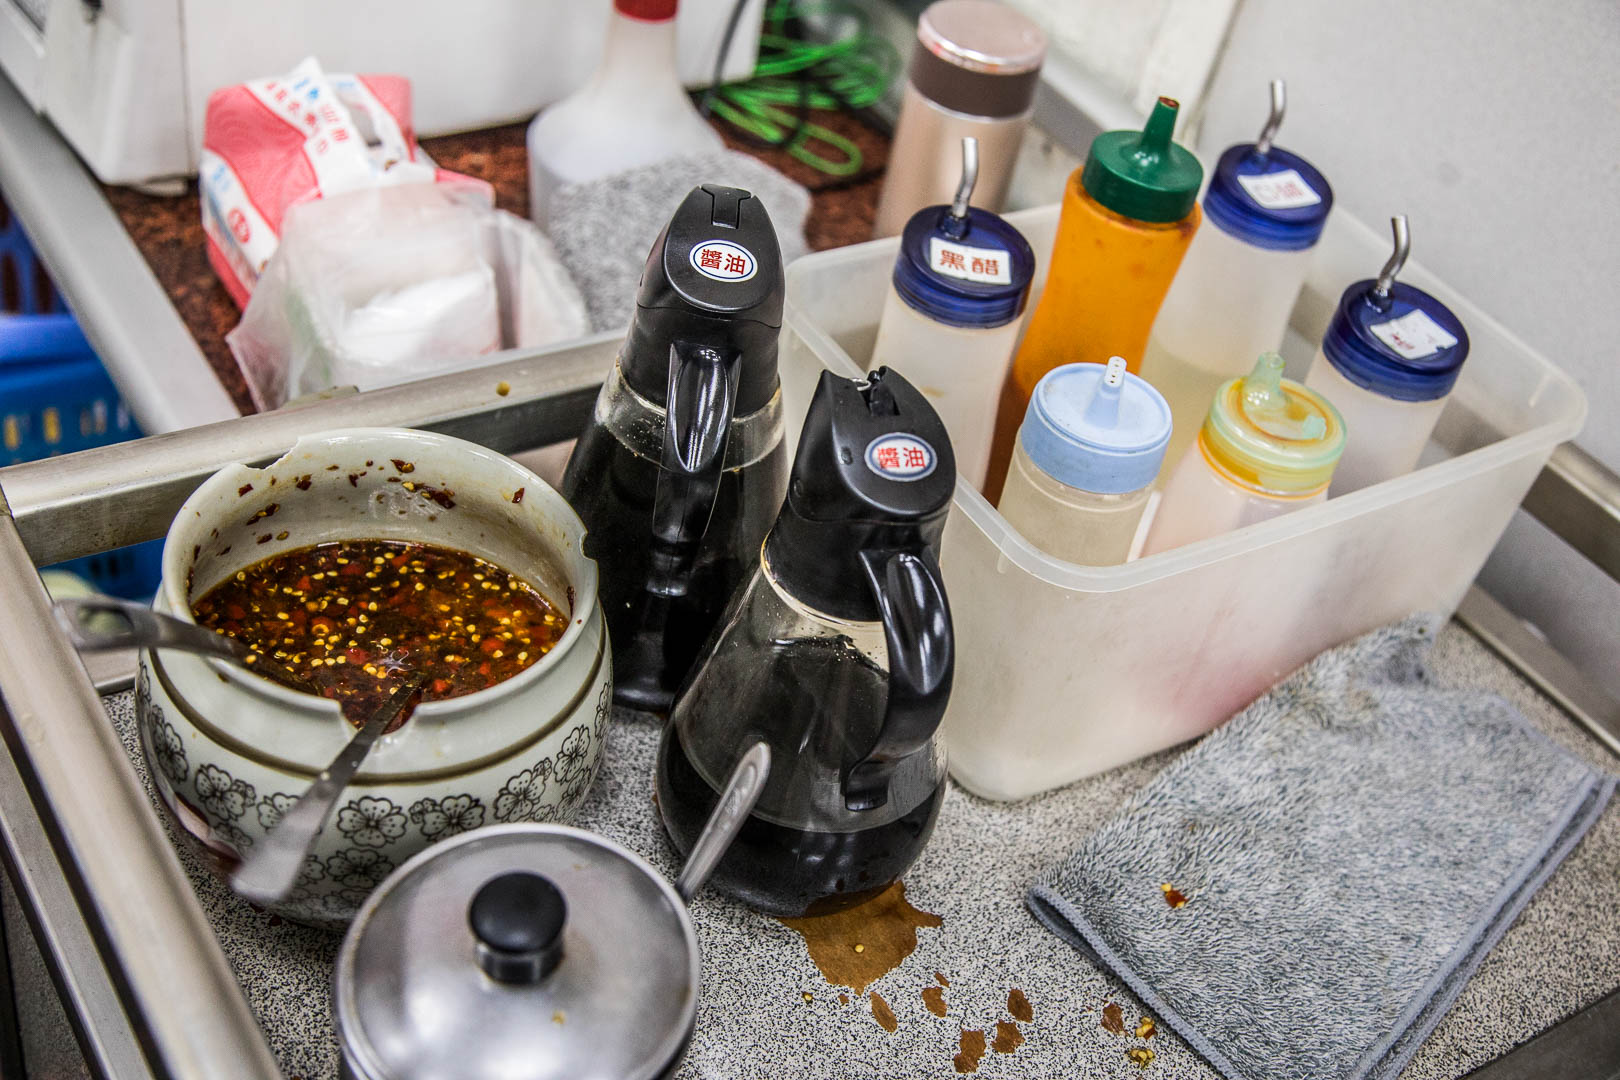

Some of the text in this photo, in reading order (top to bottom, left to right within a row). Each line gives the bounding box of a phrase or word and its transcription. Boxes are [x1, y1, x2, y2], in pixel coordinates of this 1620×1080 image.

[701, 249, 746, 275] 醬油
[940, 249, 999, 275] 黑醋
[878, 447, 926, 468] 醬油
